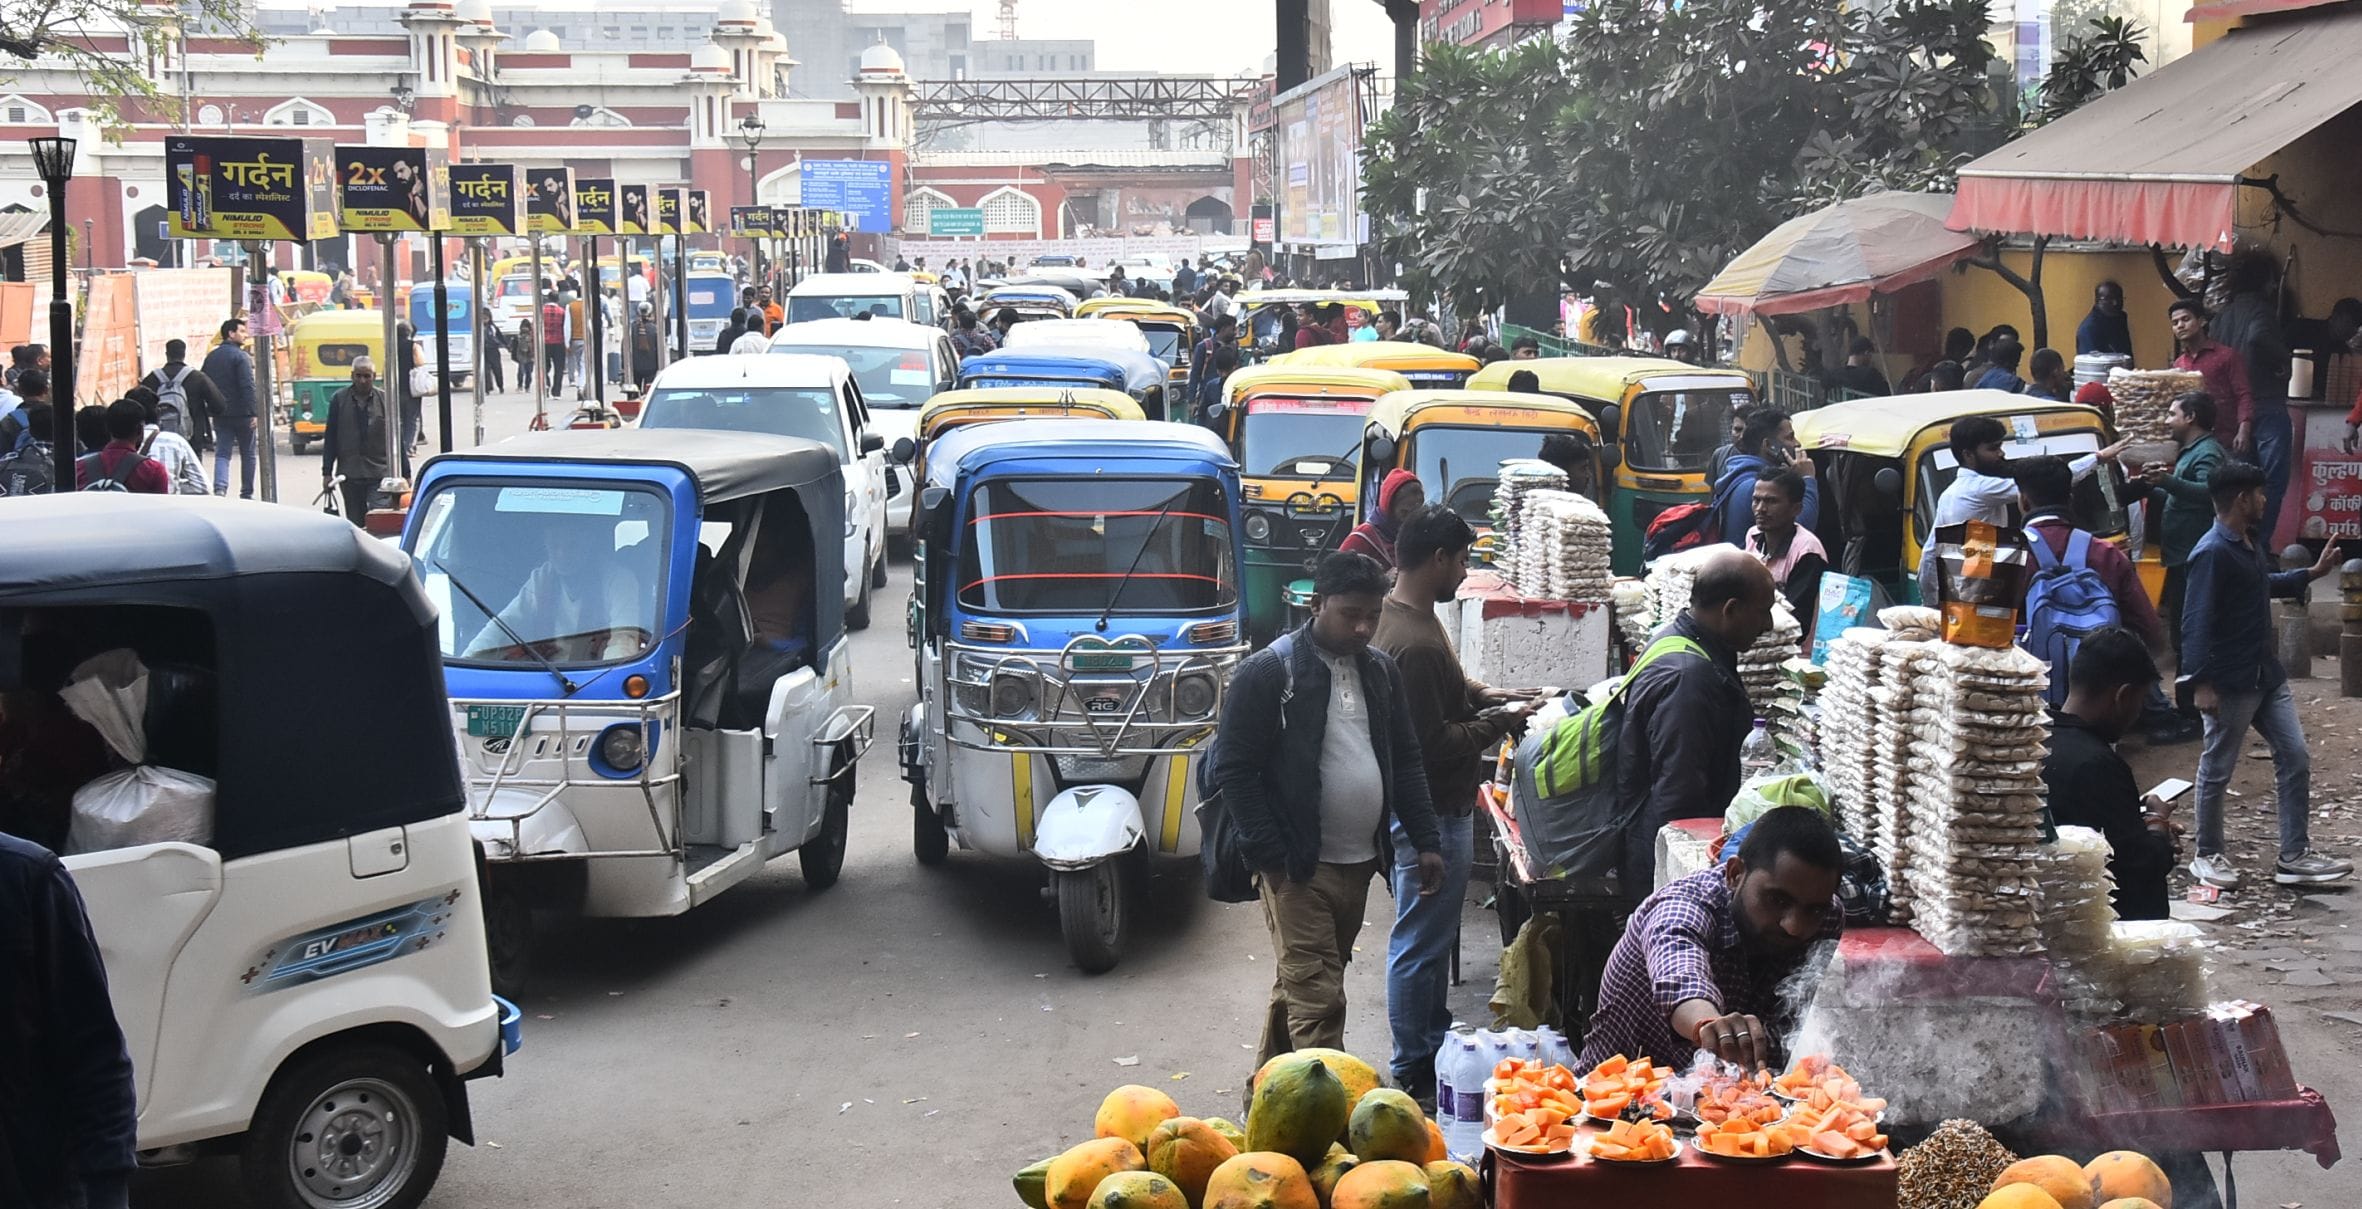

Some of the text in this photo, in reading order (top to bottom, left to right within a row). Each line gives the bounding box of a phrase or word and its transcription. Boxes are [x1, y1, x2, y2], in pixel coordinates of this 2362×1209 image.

[220, 152, 295, 190] गर्दन
[348, 162, 387, 185] 2x
[456, 173, 508, 200] गर्दन
[222, 214, 264, 222] NIMULID
[1091, 701, 1115, 711] RE
[304, 937, 338, 959] EV
